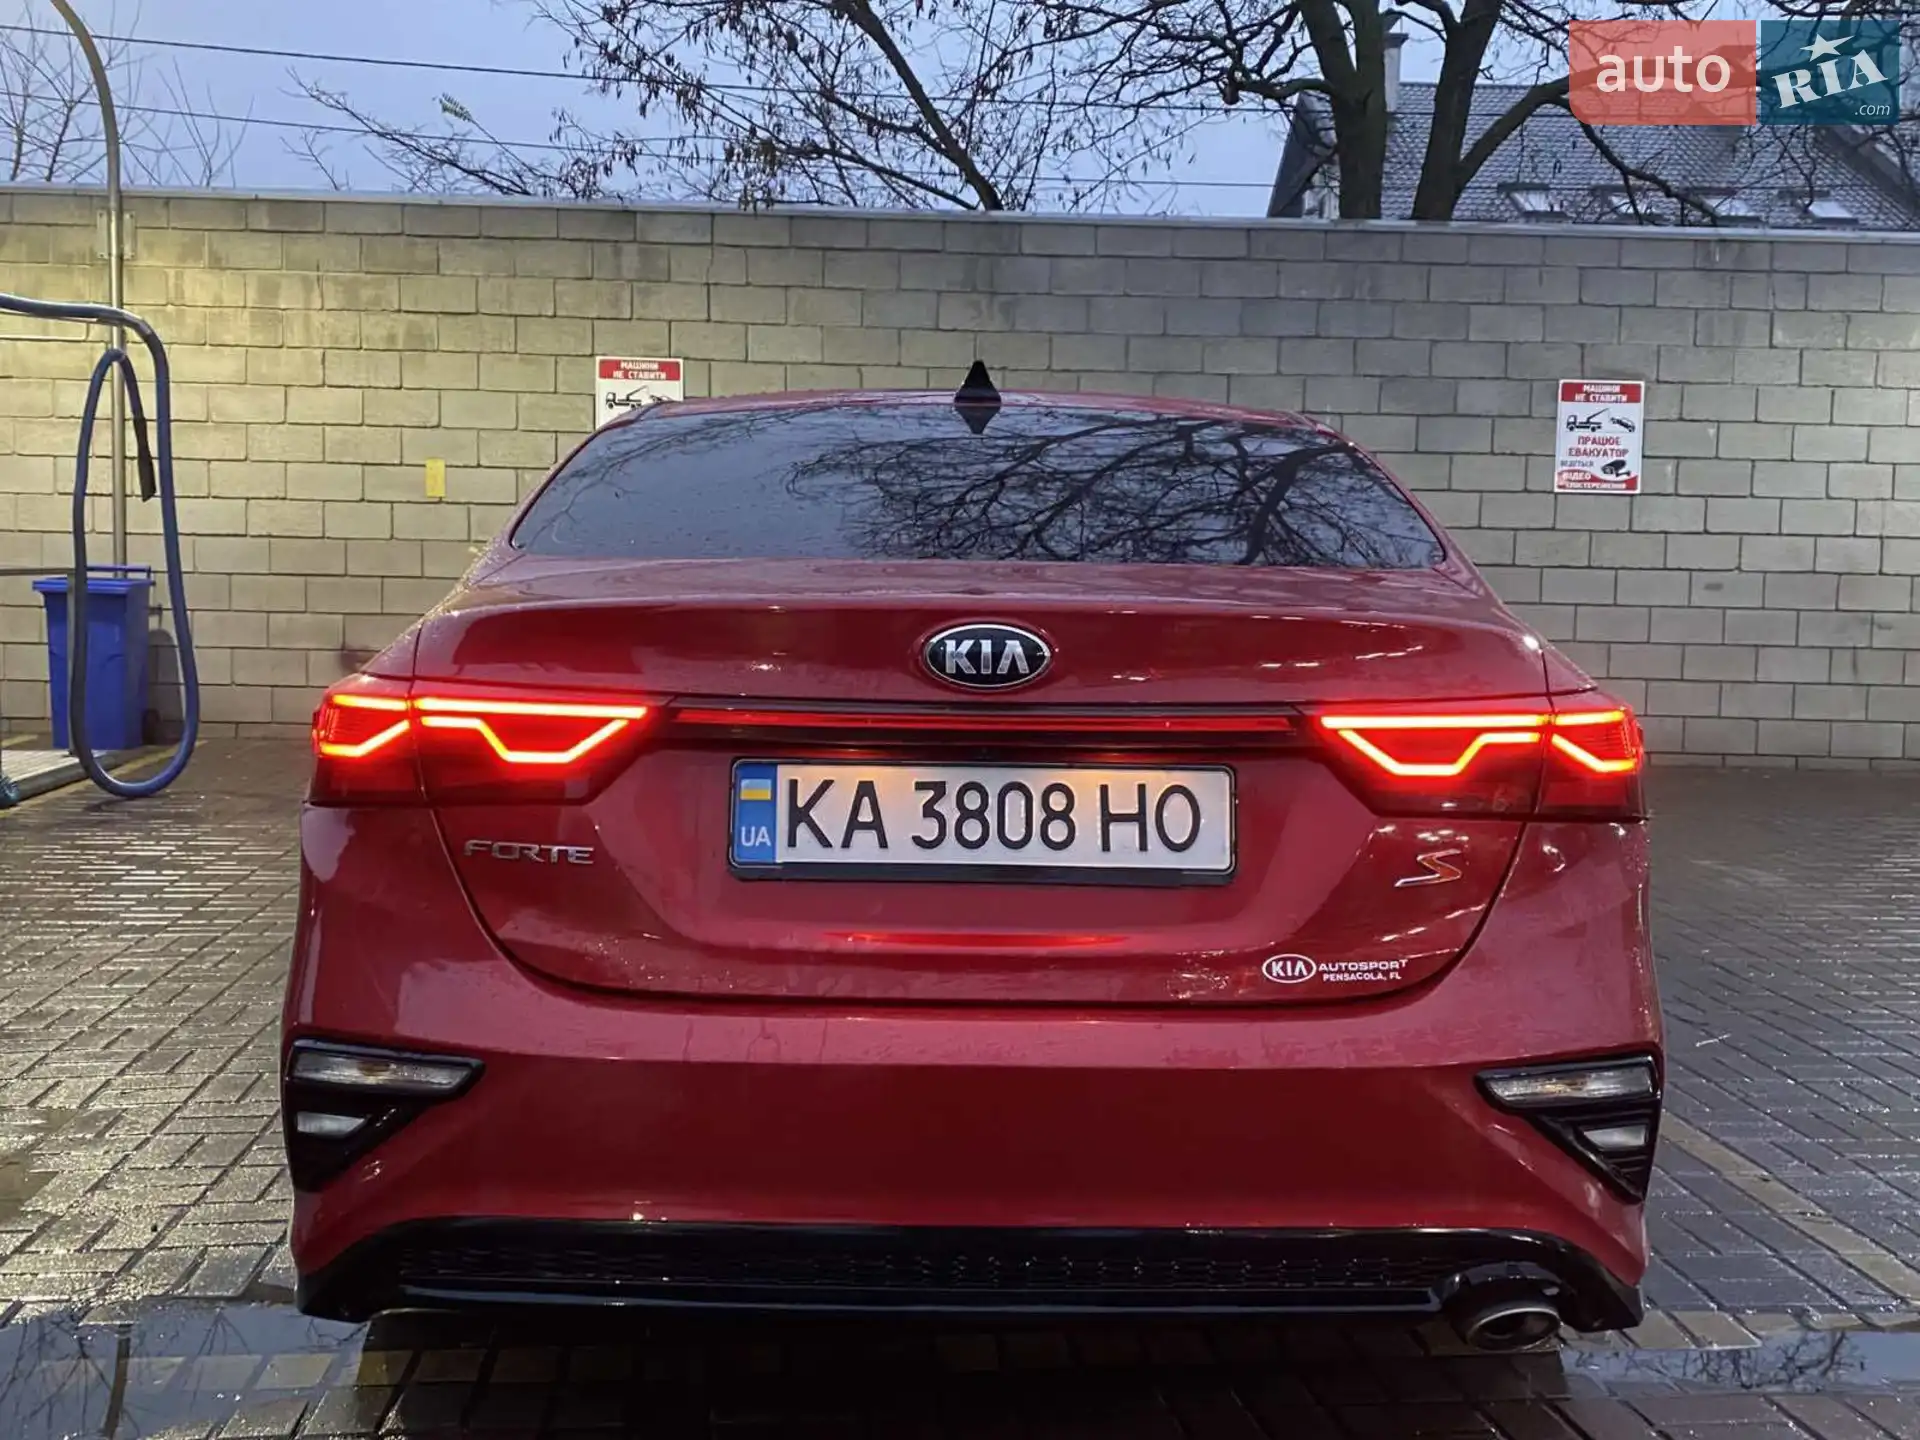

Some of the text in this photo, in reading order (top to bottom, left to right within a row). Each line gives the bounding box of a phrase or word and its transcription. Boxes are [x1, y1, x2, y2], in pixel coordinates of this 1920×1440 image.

[628, 371, 667, 380] СТАВИТИ
[944, 640, 1030, 674] KIA
[787, 778, 1201, 852] KA 3808 HO
[741, 826, 771, 846] UA
[465, 839, 594, 864] FORTE
[1271, 960, 1308, 977] KIA
[1318, 959, 1409, 973] AUTOSPORT
[1323, 971, 1402, 982] PENSACOLA, FL
